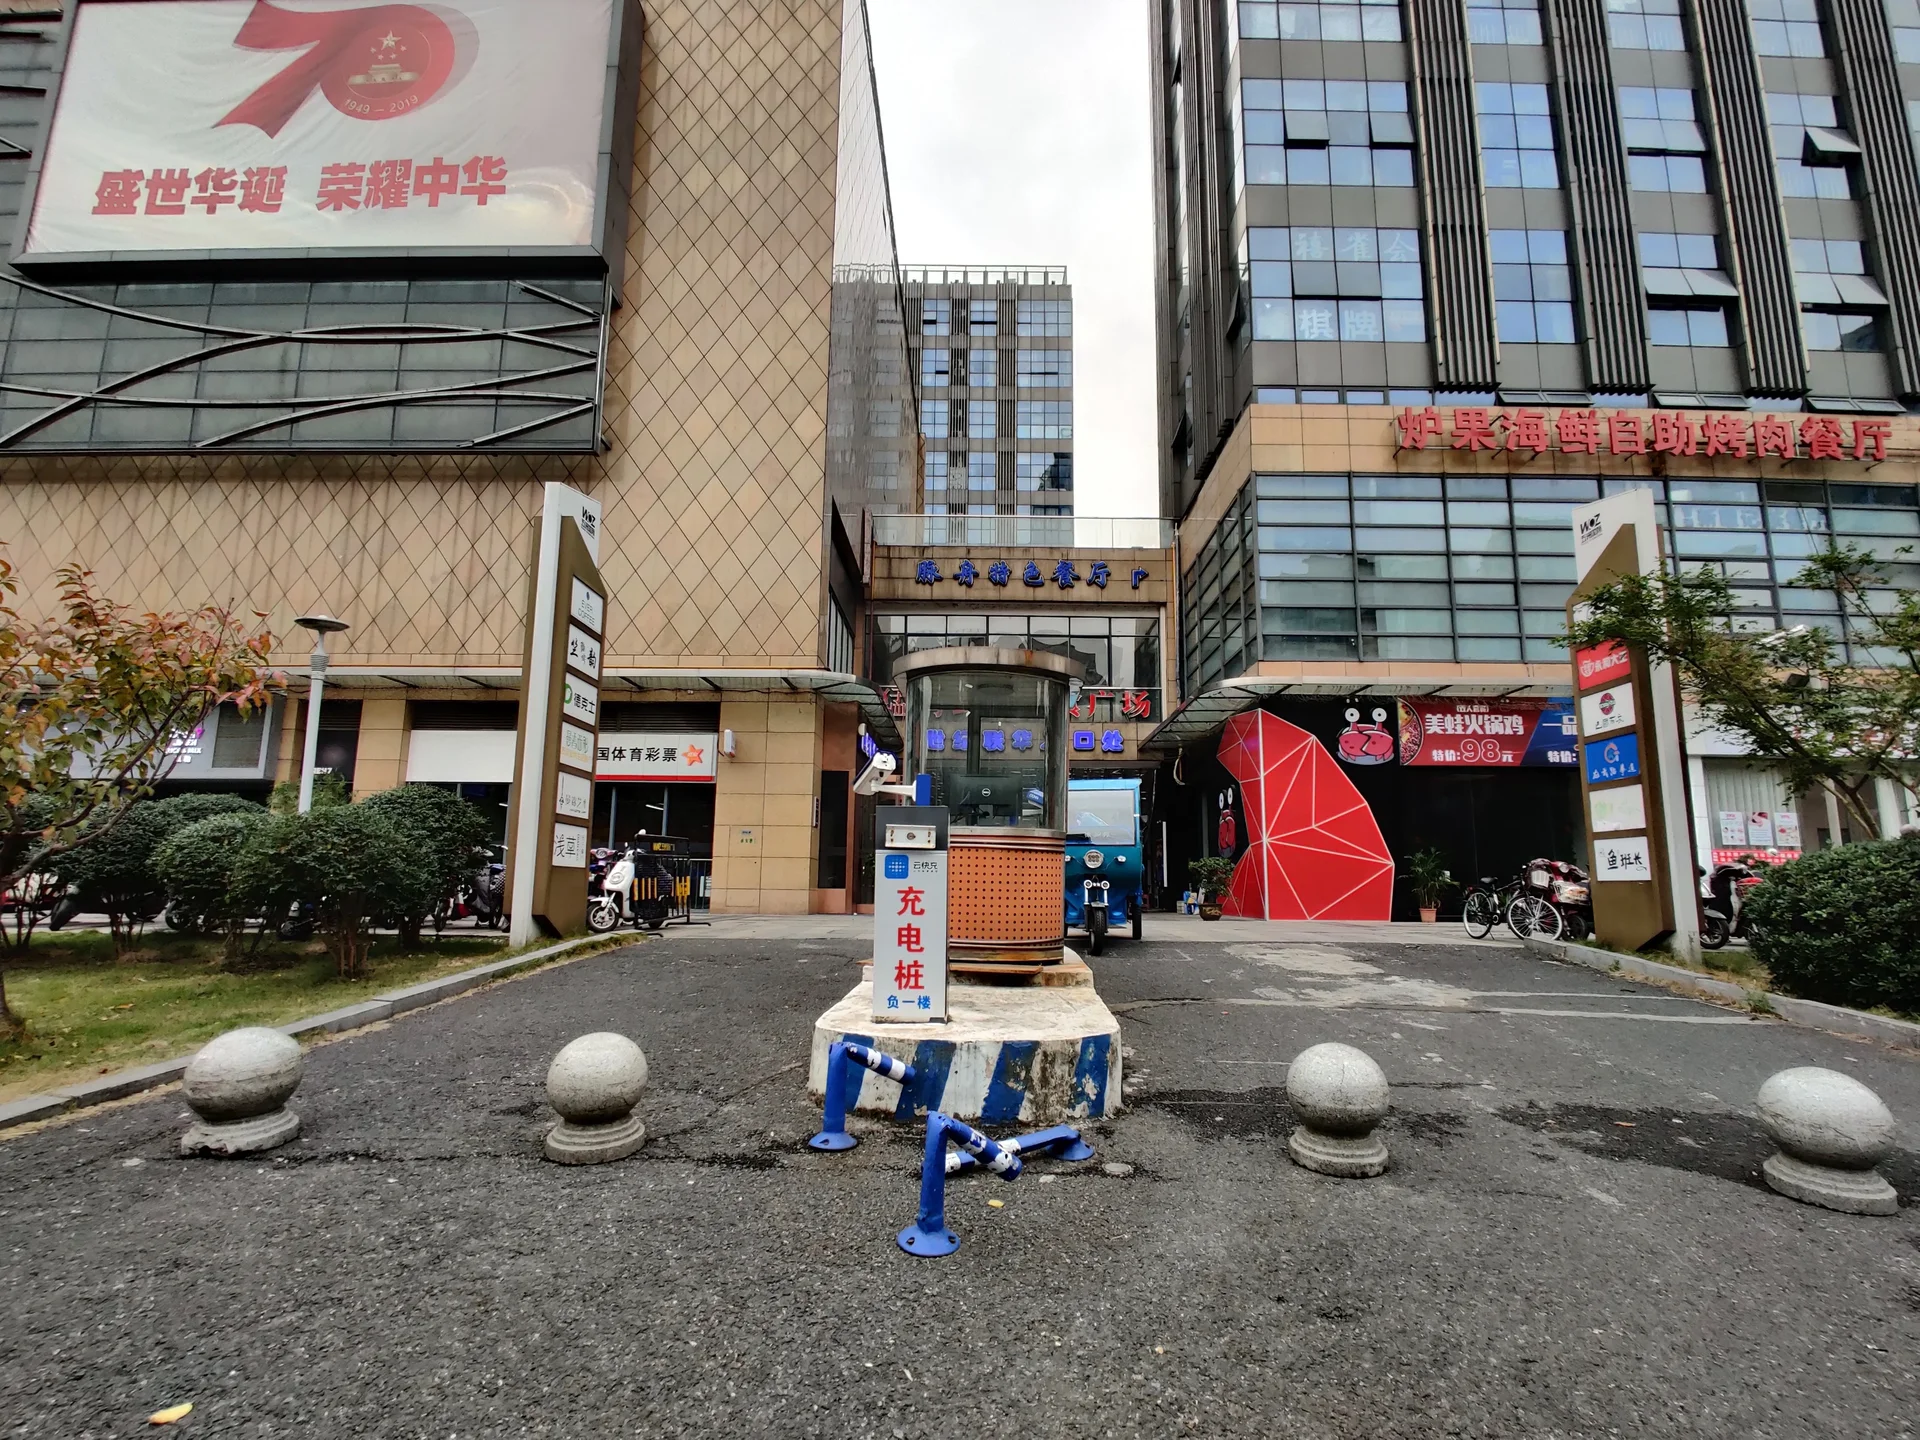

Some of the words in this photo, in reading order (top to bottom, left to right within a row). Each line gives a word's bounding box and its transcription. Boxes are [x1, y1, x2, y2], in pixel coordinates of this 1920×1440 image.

[344, 97, 371, 115] 1949
[388, 94, 420, 113] 2019
[91, 166, 288, 215] 盛世华诞
[316, 156, 508, 212] 荣耀中华
[1299, 309, 1378, 340] 棋牌
[1397, 405, 1893, 461] 炉果海鲜自助烤肉餐厅
[1425, 713, 1525, 735] 美蛙火锅鸡
[926, 728, 1124, 753] 世纪联华口处
[597, 746, 678, 762] 国体育彩票
[913, 861, 938, 870] 云快充
[1607, 848, 1643, 870] 鱼班长
[894, 886, 926, 990] 充电桩
[887, 994, 931, 1010] 负一楼
